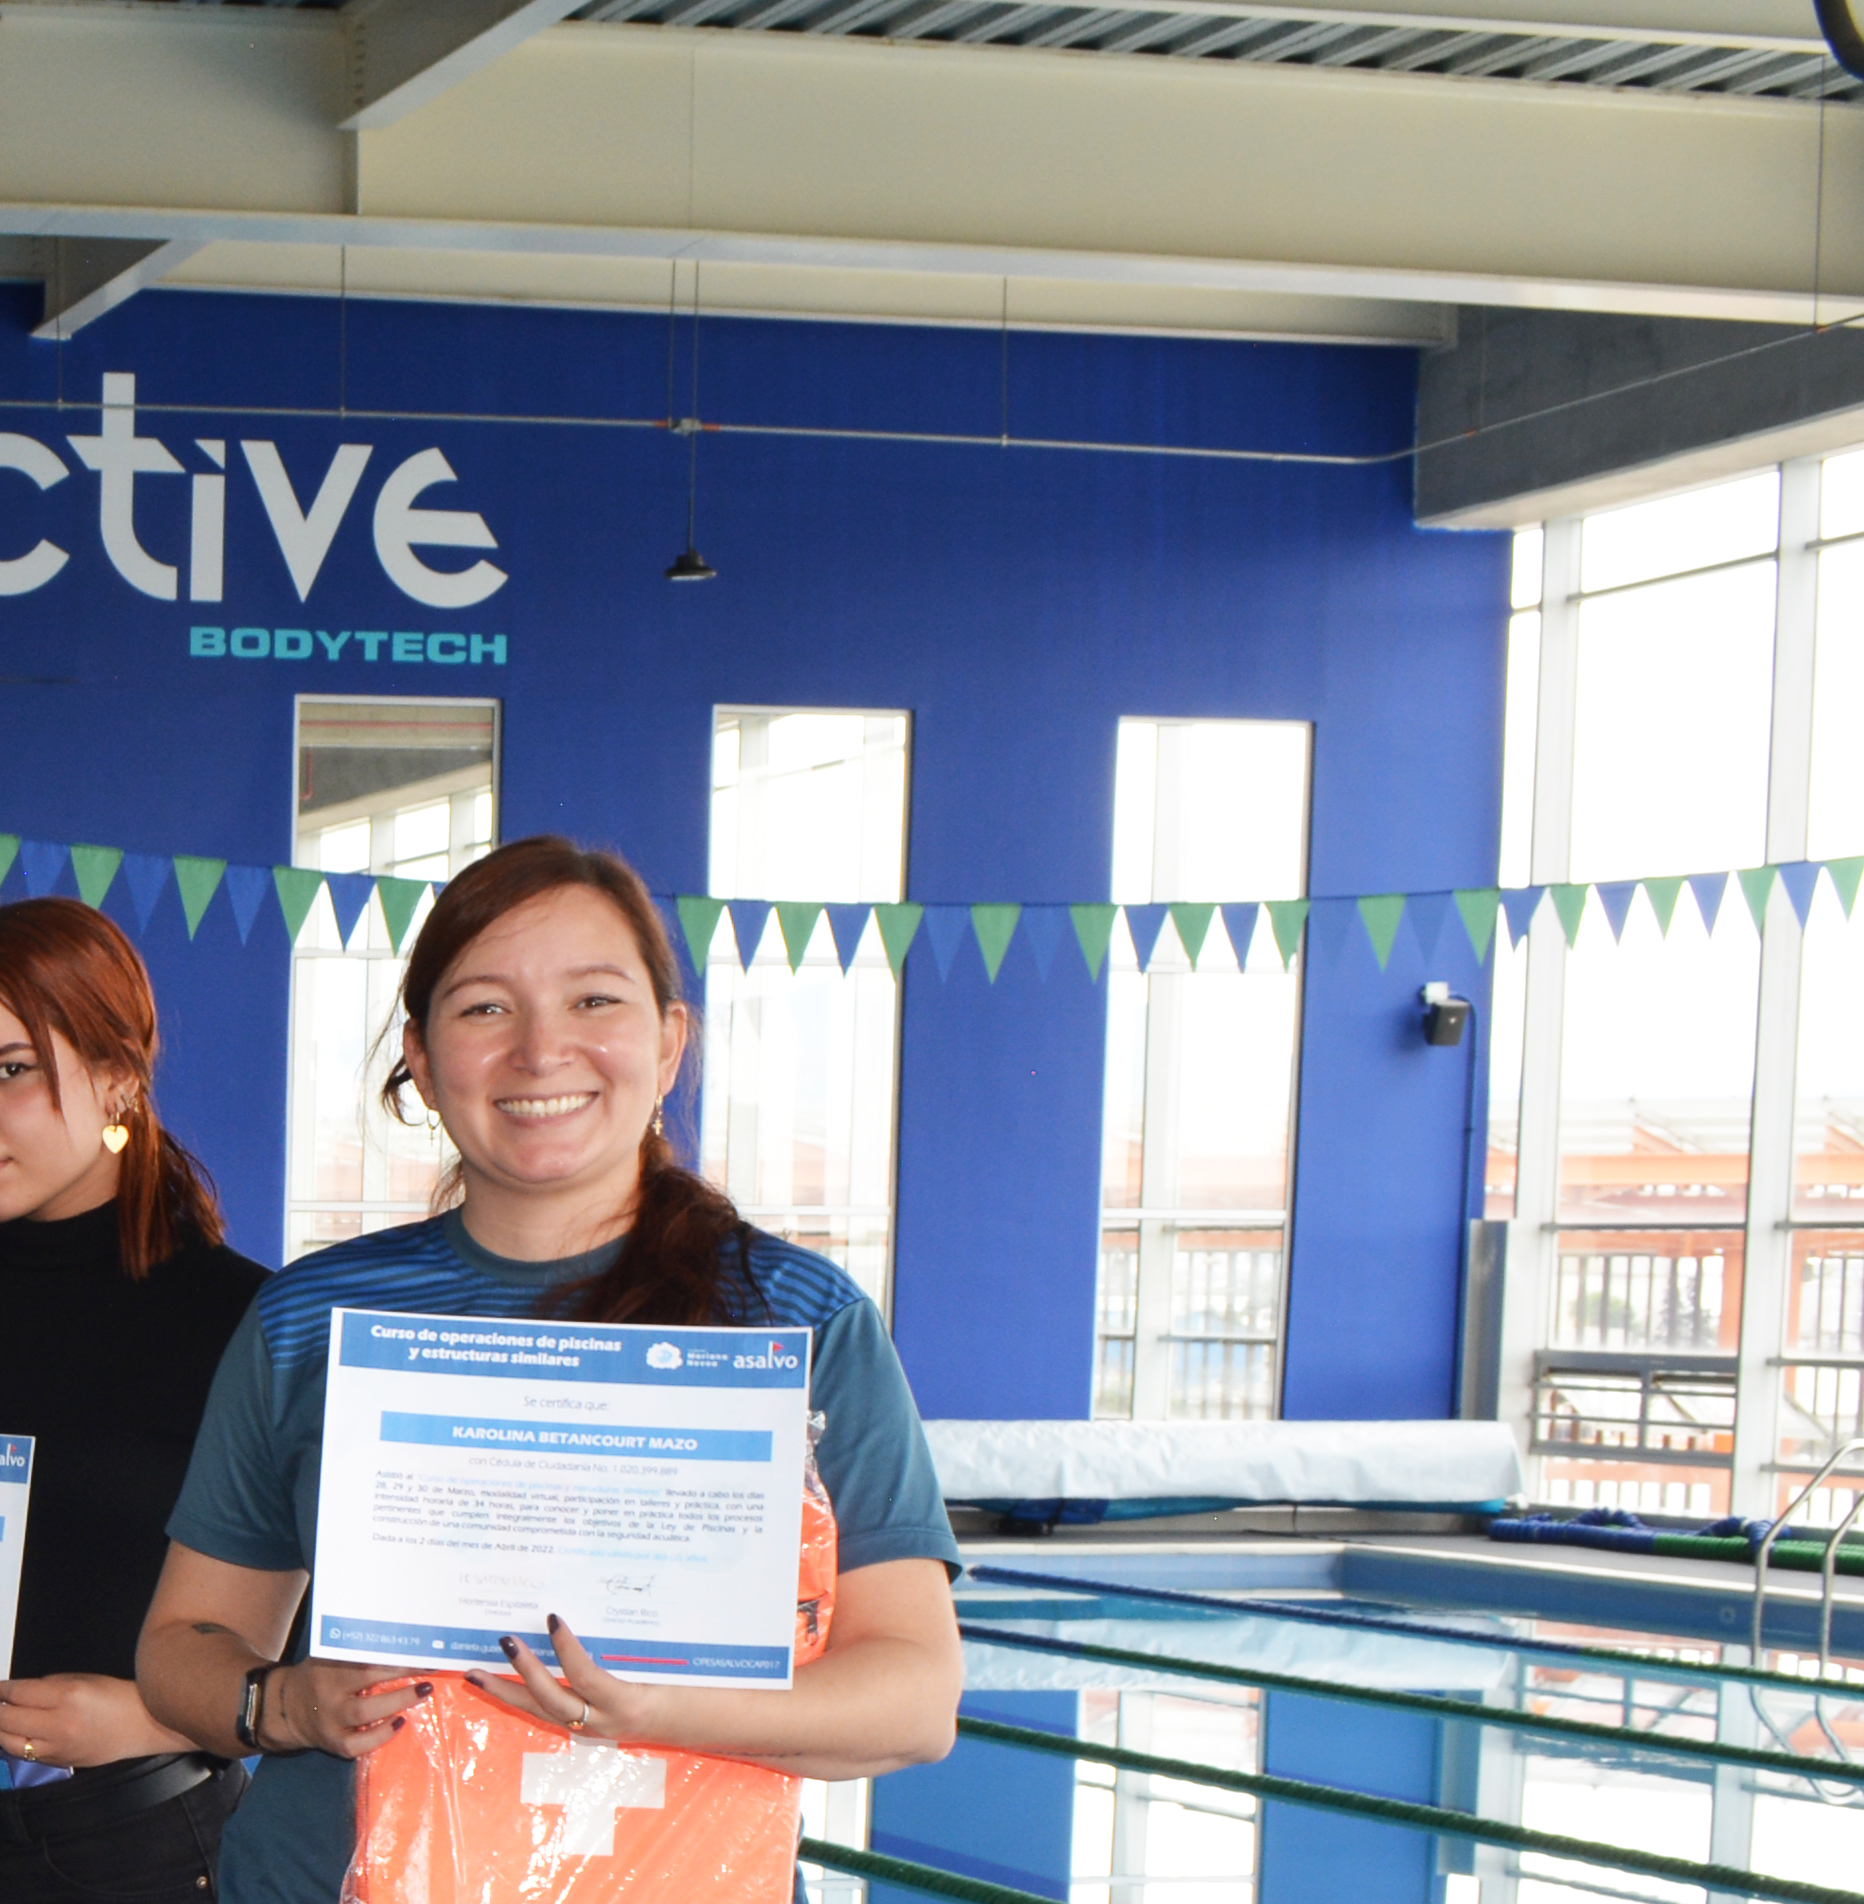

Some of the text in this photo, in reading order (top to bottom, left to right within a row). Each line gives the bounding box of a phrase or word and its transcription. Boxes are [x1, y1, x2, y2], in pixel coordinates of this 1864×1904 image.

[188, 625, 509, 665] BODYTECH
[371, 1324, 620, 1354] Curso de operaciones de piscinas
[409, 1347, 579, 1366] y estructuras similares
[732, 1340, 799, 1371] asalvo
[452, 1426, 698, 1450] KAROLINA BETANCOURT MAZO
